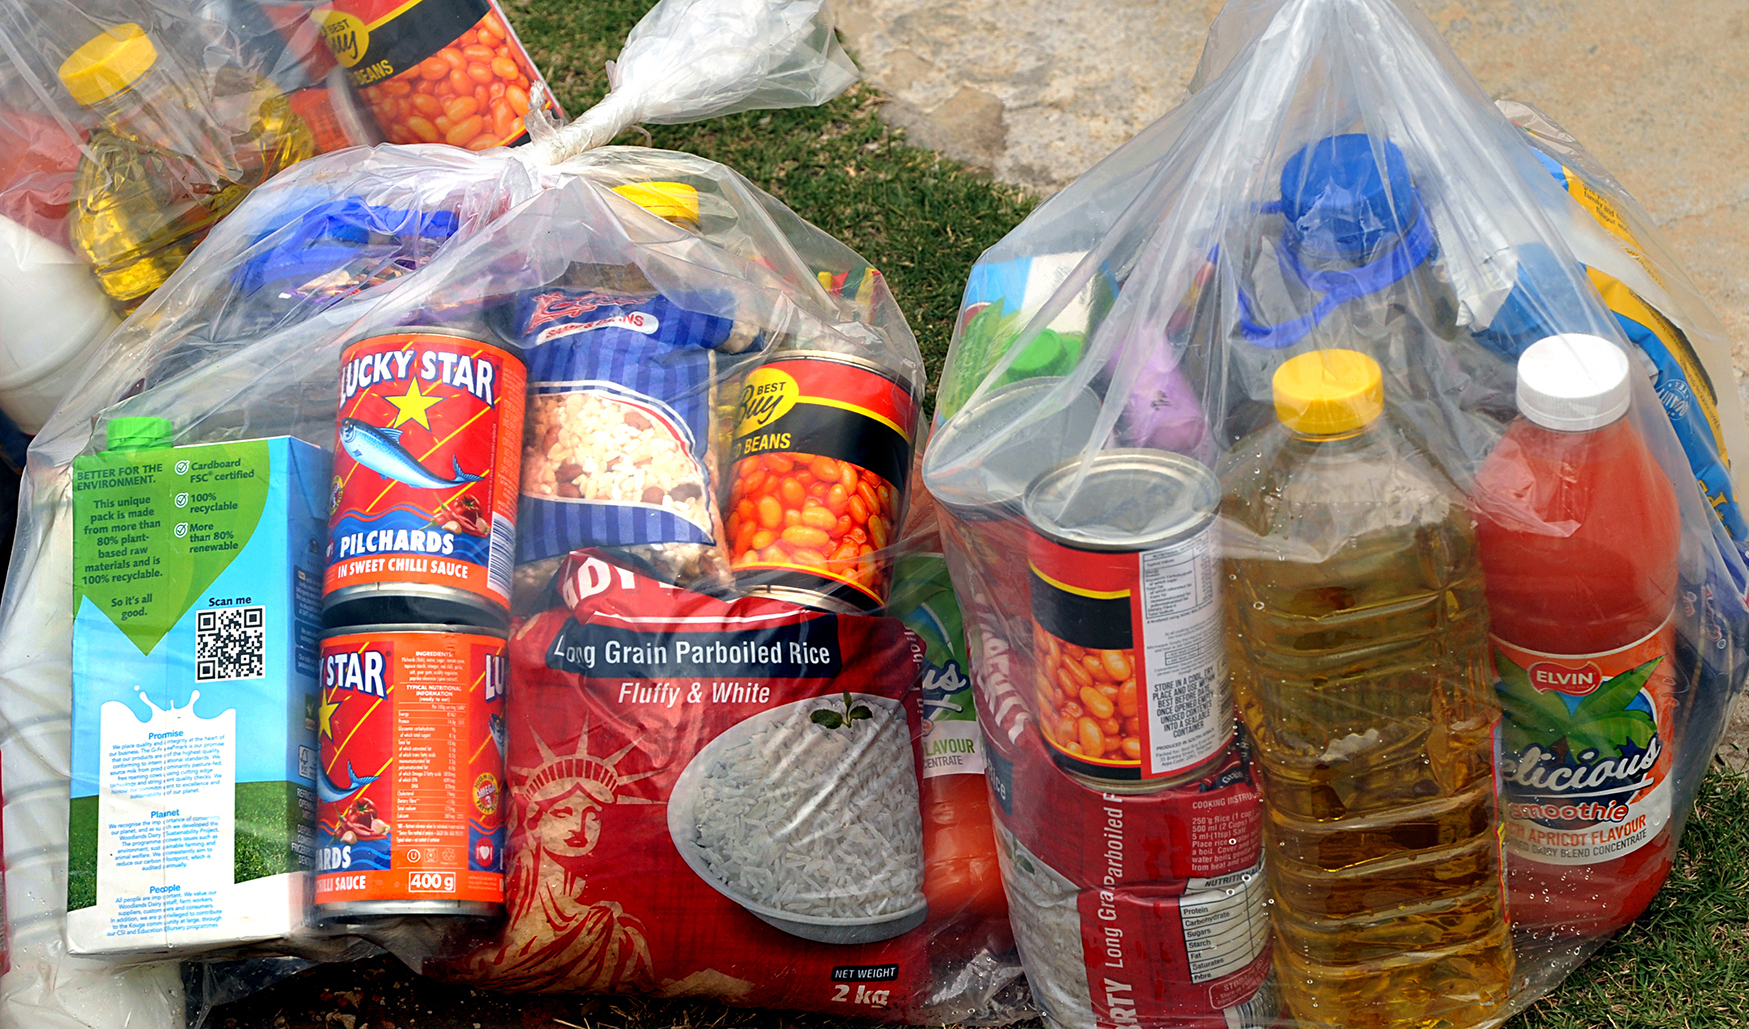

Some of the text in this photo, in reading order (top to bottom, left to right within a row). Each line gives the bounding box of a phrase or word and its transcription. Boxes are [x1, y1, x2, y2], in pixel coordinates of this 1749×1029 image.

[340, 350, 416, 409] LUCKY
[420, 350, 495, 409] STAR
[757, 382, 786, 395] BEST
[1675, 382, 1688, 394] TEA
[736, 384, 784, 429] Buy
[744, 433, 791, 454] BEANS
[191, 458, 241, 471] Cardboard
[77, 464, 163, 480] BETTER FOR THE
[214, 469, 254, 480] certified
[77, 475, 156, 491] ENVIRONMENT.
[93, 496, 151, 509] This unique
[191, 493, 216, 502] 100%
[190, 501, 238, 514] recyclable
[90, 507, 154, 524] pack is made
[84, 520, 160, 535] from more than
[189, 523, 214, 532] More
[97, 533, 149, 546] 80% plant-
[190, 531, 234, 542] than 80%
[340, 529, 454, 558] PILCHARDS
[98, 547, 148, 558] based raw
[190, 541, 238, 553] renewable
[85, 556, 160, 572] materials and is
[338, 558, 468, 579] IN SWEET CHILLI SAUCE
[82, 568, 163, 585] 100% recyclable.
[111, 594, 153, 607] So it's all
[208, 596, 252, 607] Scan me
[121, 607, 147, 621] good.
[554, 634, 831, 669] Long Grain Parboiled Rice
[326, 650, 388, 700] STAR
[1536, 670, 1593, 684] ELVIN
[1153, 690, 1172, 700] PLACE
[1174, 686, 1186, 696] AND
[1187, 682, 1197, 692] USE
[1154, 681, 1174, 692] STORE
[1176, 679, 1181, 687] IN
[618, 681, 770, 708] Fluffy & White
[1158, 698, 1173, 708] BEST
[1175, 691, 1196, 704] BEFORE
[1157, 706, 1172, 716] ONCE
[1175, 699, 1197, 712] OPENED
[1161, 712, 1185, 724] UNUSED
[1164, 722, 1178, 731] INTO
[1173, 720, 1204, 738] CONTAINER
[924, 738, 975, 756] LAVOUR
[477, 783, 496, 799] OMEGA
[486, 796, 492, 808] 3
[1192, 798, 1225, 809] COOKING
[1510, 800, 1629, 822] smoothie
[1192, 817, 1206, 825] 250
[1528, 814, 1647, 847] APRICOT FLAVOUR
[1561, 849, 1590, 857] BLEND
[1593, 829, 1647, 856] CONCENTRATE
[1192, 863, 1208, 871] from
[1211, 861, 1226, 870] heat
[335, 875, 366, 890] SAUCE
[411, 874, 442, 888] 400
[444, 876, 454, 889] g
[1183, 907, 1208, 915] Protein
[1185, 911, 1230, 927] Carbohydrate
[1187, 928, 1211, 938] Sugars
[1105, 927, 1123, 968] Long
[1188, 940, 1211, 949] Starch
[1192, 957, 1224, 970] Saturates
[835, 967, 896, 978] NET WEIGHT
[831, 984, 850, 1002] 2
